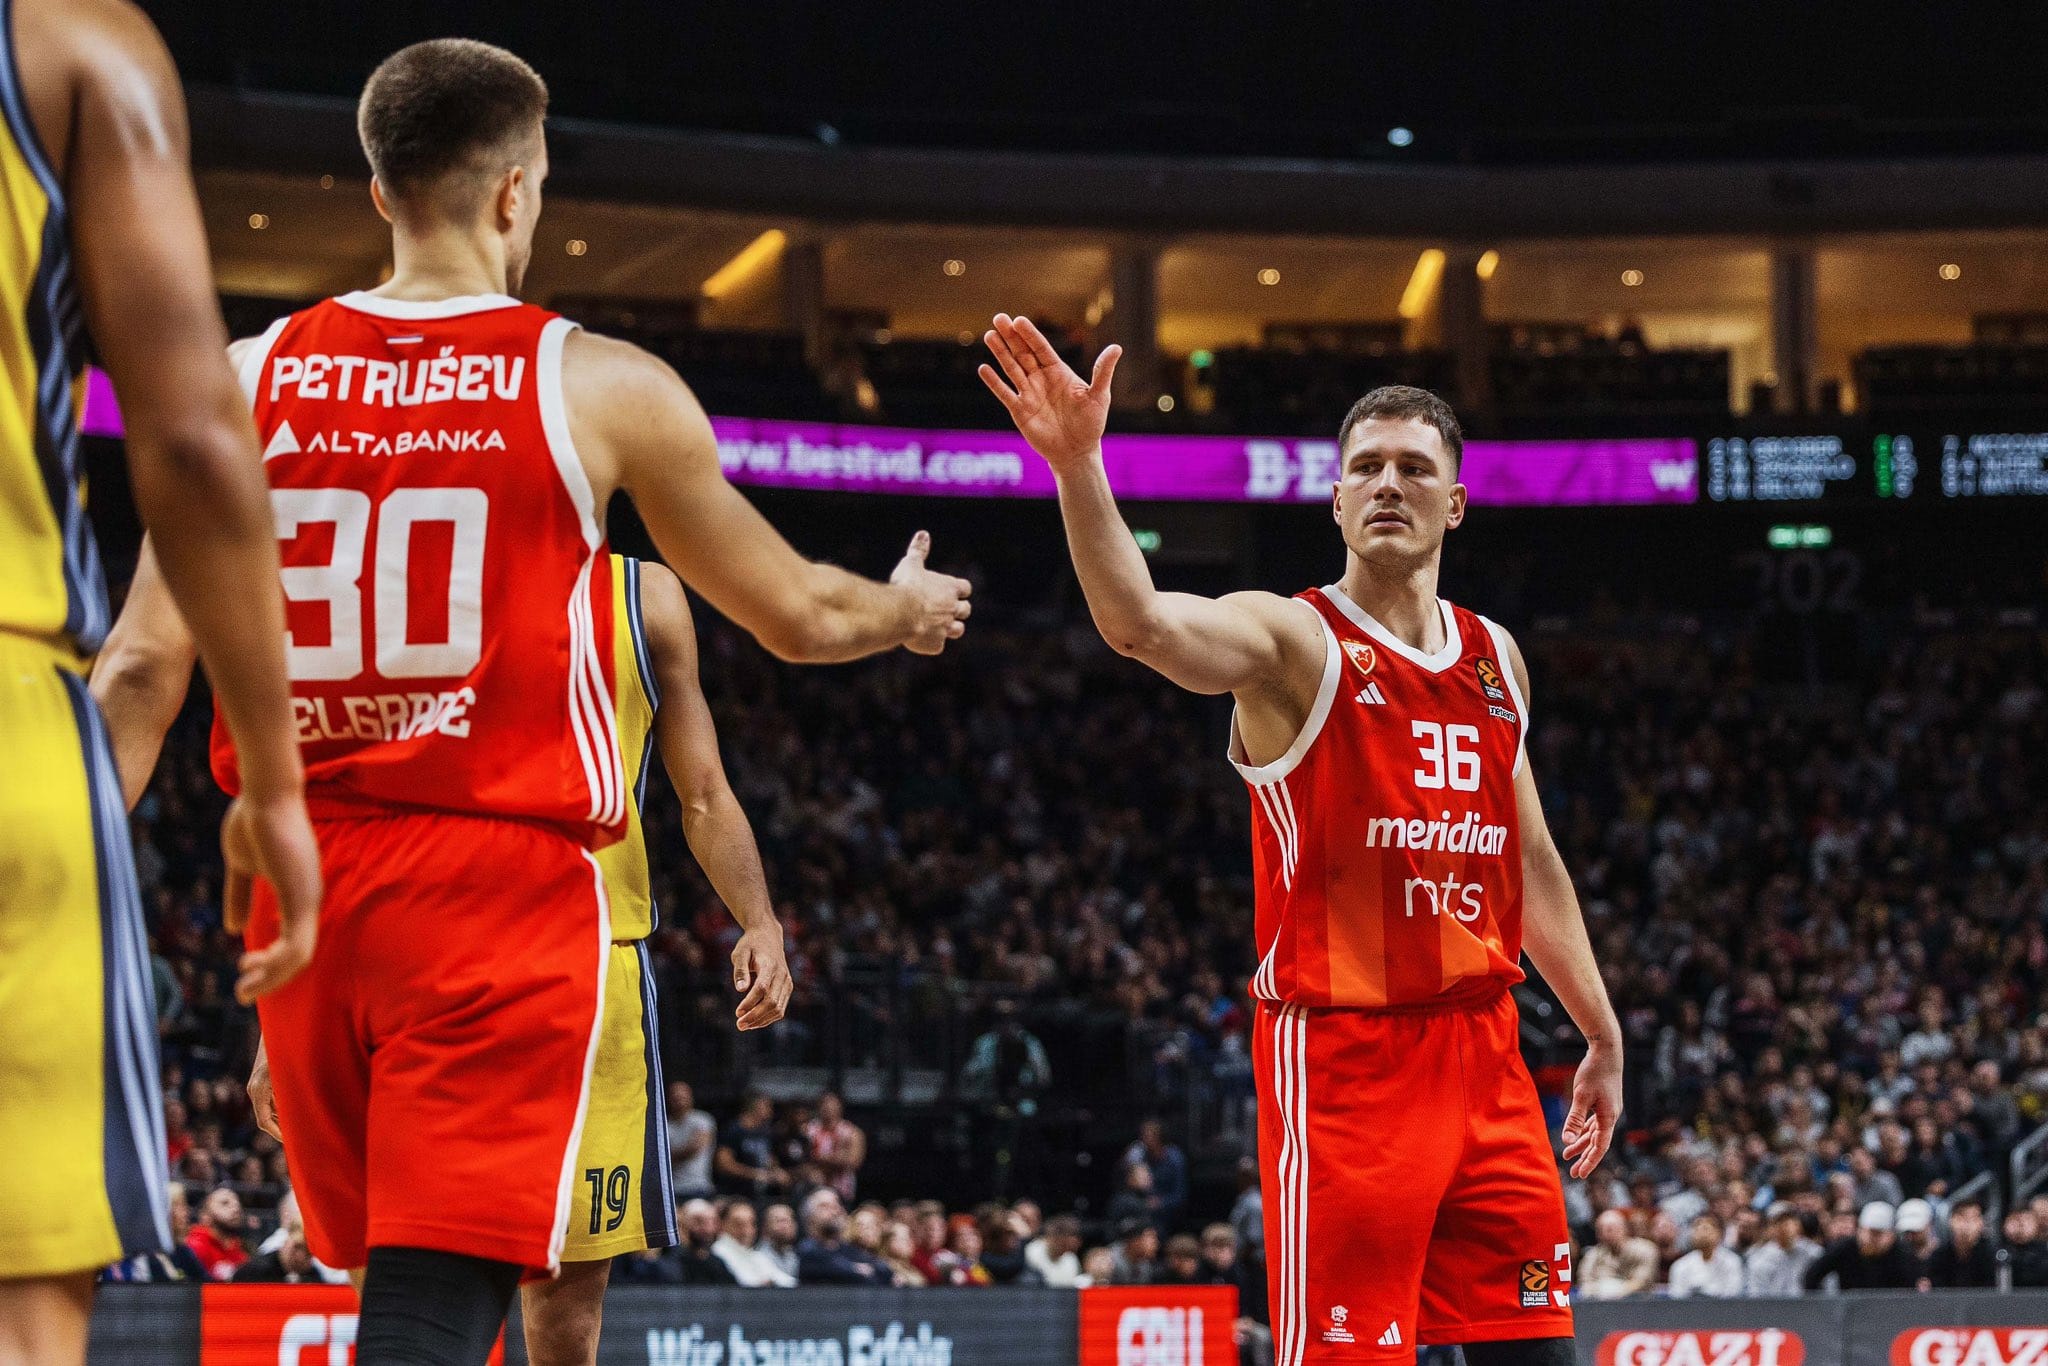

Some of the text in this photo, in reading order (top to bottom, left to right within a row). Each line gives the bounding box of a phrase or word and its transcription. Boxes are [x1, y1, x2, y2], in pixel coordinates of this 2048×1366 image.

[270, 345, 525, 407] PETRUŠEV
[306, 429, 506, 457] ALTABANKA
[271, 487, 489, 681] 30
[288, 687, 476, 742] ELGRADE
[1411, 719, 1481, 792] 36
[1365, 810, 1507, 855] meridian
[585, 1165, 630, 1234] 19
